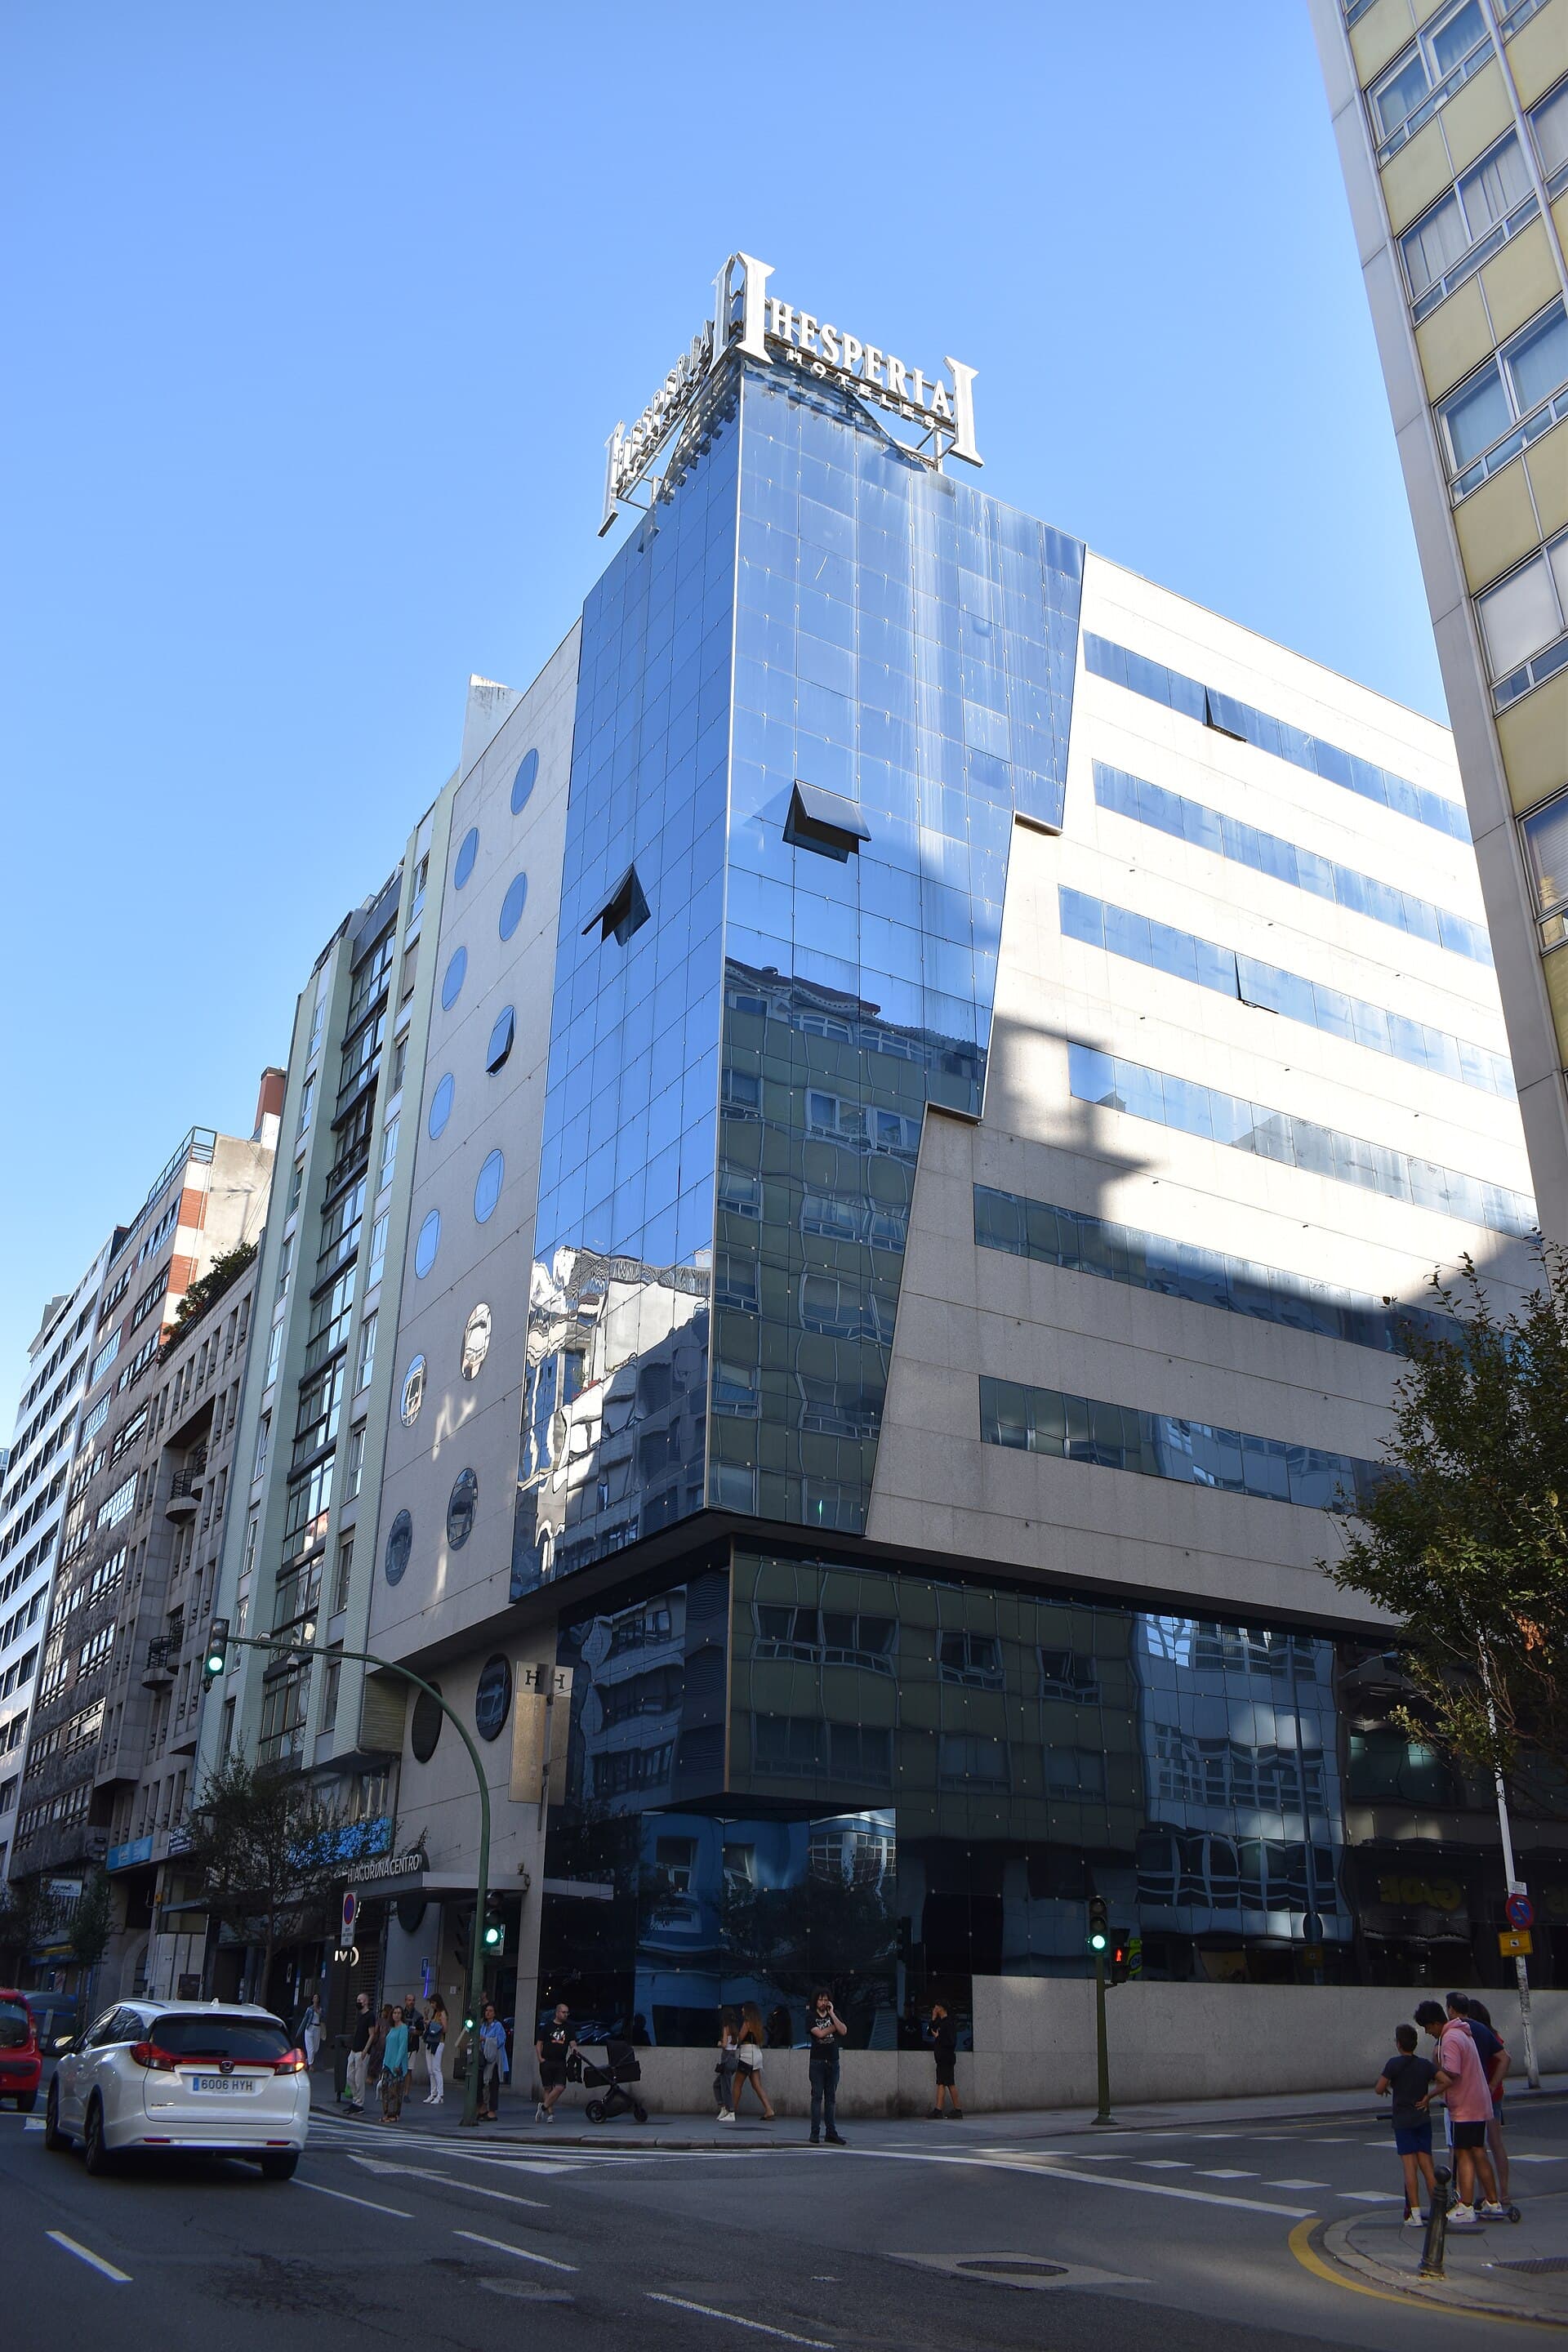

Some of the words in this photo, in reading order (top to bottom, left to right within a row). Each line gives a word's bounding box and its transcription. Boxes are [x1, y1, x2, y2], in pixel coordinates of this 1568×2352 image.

[770, 296, 952, 422] HESPERIA
[786, 348, 937, 430] HOTELES
[525, 1670, 540, 1686] H
[390, 1854, 420, 1876] CENTRO
[202, 2079, 229, 2090] 6006
[232, 2080, 252, 2091] HYH
